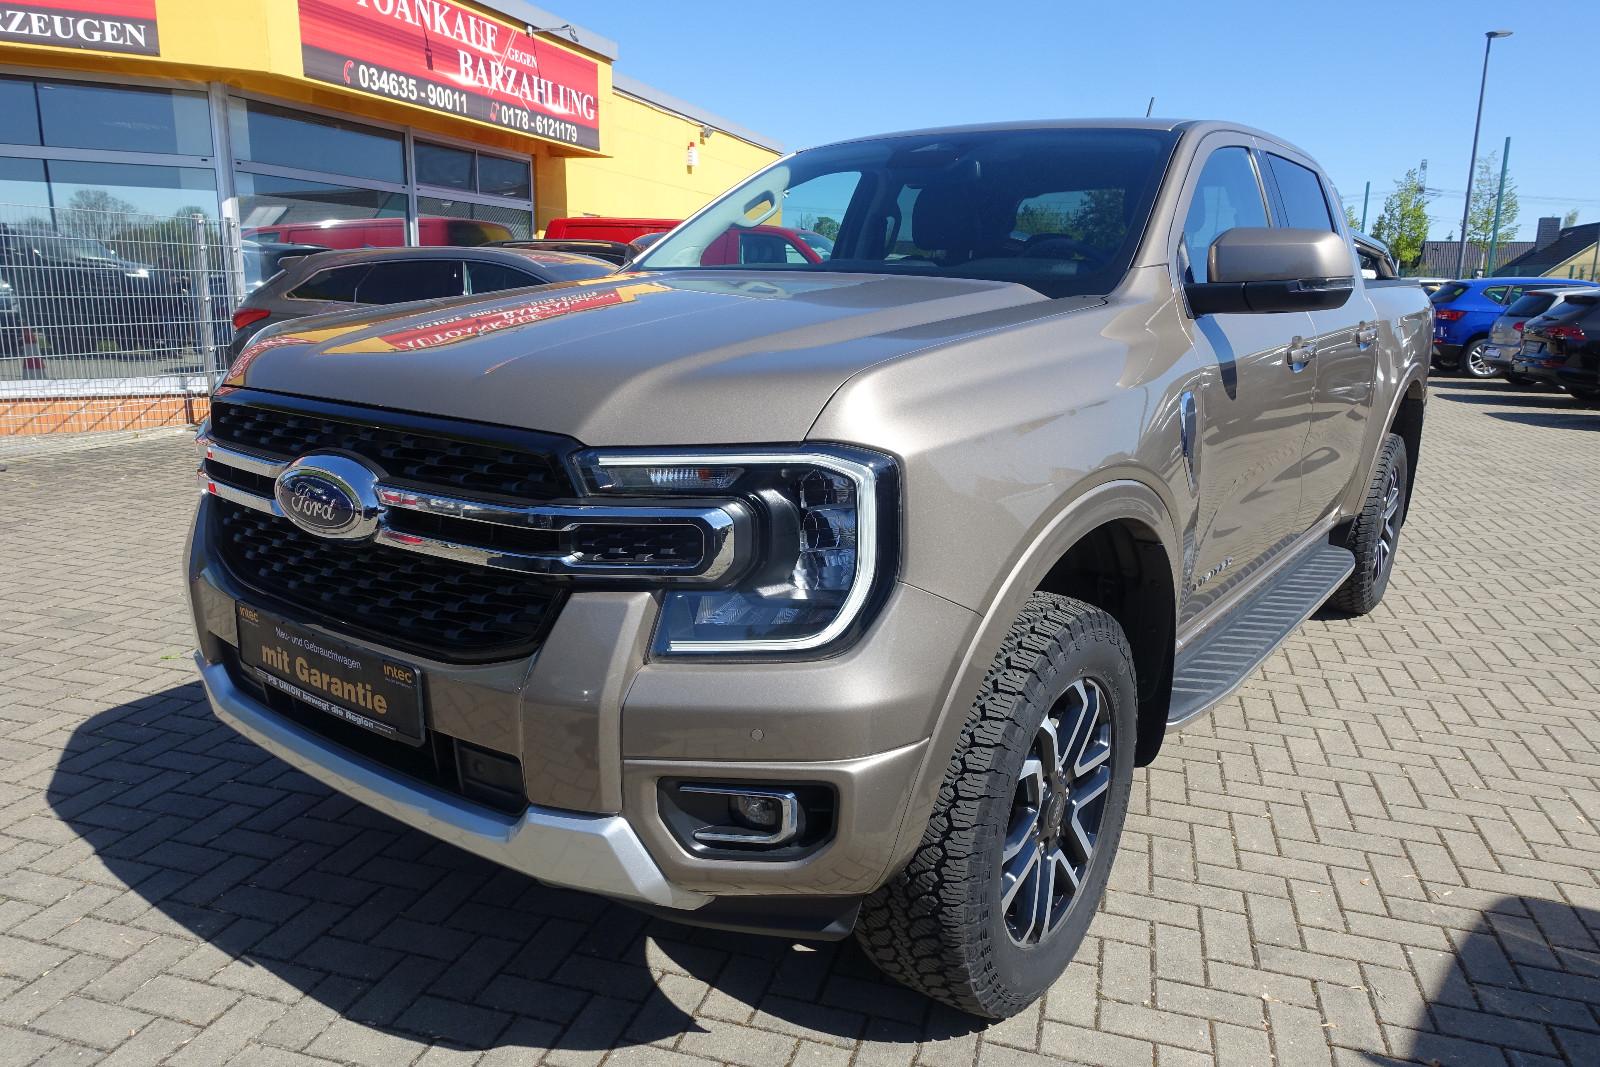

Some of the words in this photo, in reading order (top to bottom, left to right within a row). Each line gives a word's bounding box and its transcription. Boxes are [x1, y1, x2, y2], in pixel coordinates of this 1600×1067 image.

[355, 0, 498, 54] OANKAUF
[508, 48, 538, 68] GEGEN
[457, 49, 595, 121] BARZAHLUNG
[291, 481, 336, 521] Ford
[291, 634, 303, 648] und
[261, 644, 290, 674] mit
[295, 656, 388, 715] Garantie
[383, 664, 413, 684] intec
[279, 679, 302, 699] UNION
[302, 690, 330, 712] bewegt
[331, 703, 345, 717] die
[345, 710, 375, 729] Region
